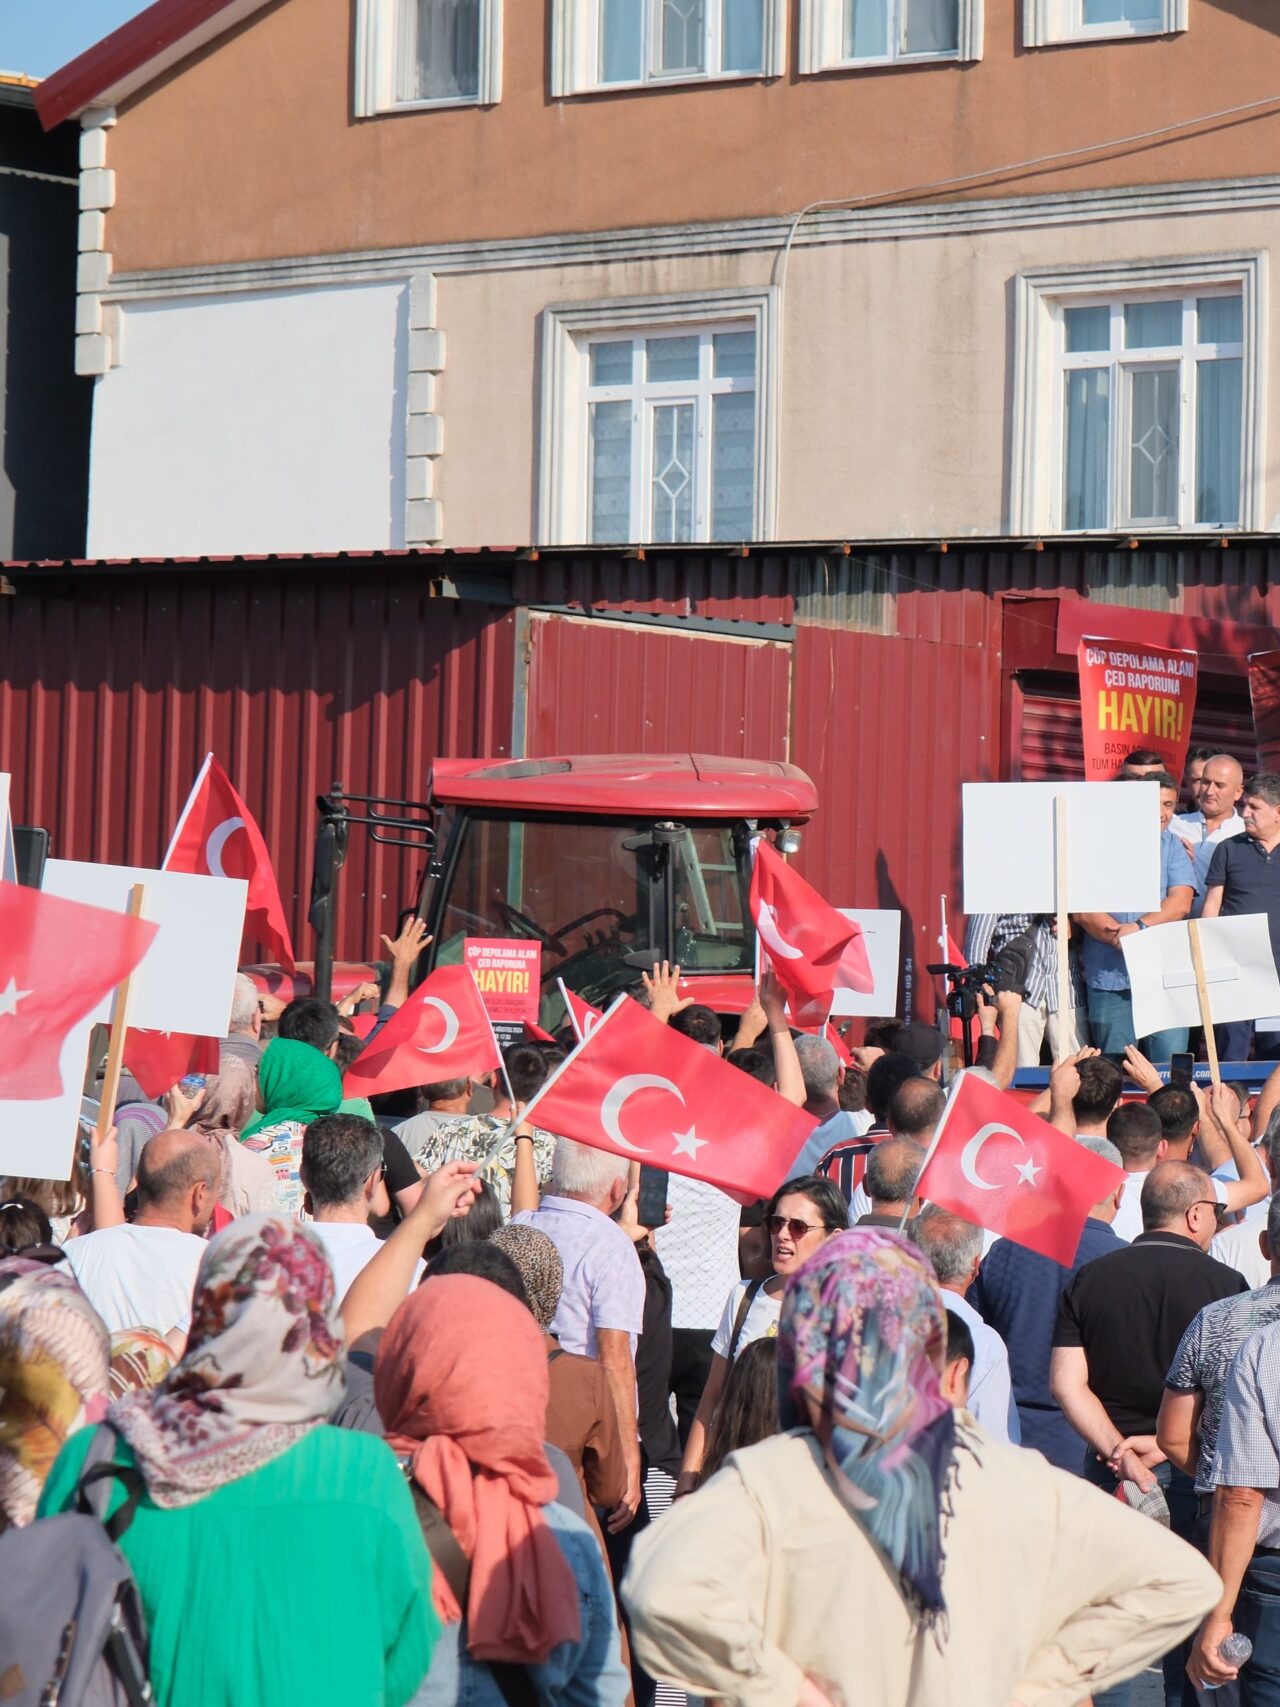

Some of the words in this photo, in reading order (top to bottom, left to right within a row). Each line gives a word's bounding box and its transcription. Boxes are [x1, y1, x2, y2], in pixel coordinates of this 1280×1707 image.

[1086, 648, 1107, 666] ÇÖP
[1110, 652, 1165, 672] DEPOLAMA
[1167, 659, 1194, 678] ALANI
[1105, 670, 1126, 689] ÇED
[1128, 674, 1181, 695] RAPORUNA
[1098, 690, 1184, 742] HAYIR!
[1092, 757, 1109, 770] TÜM
[474, 969, 529, 993] HAYIR!
